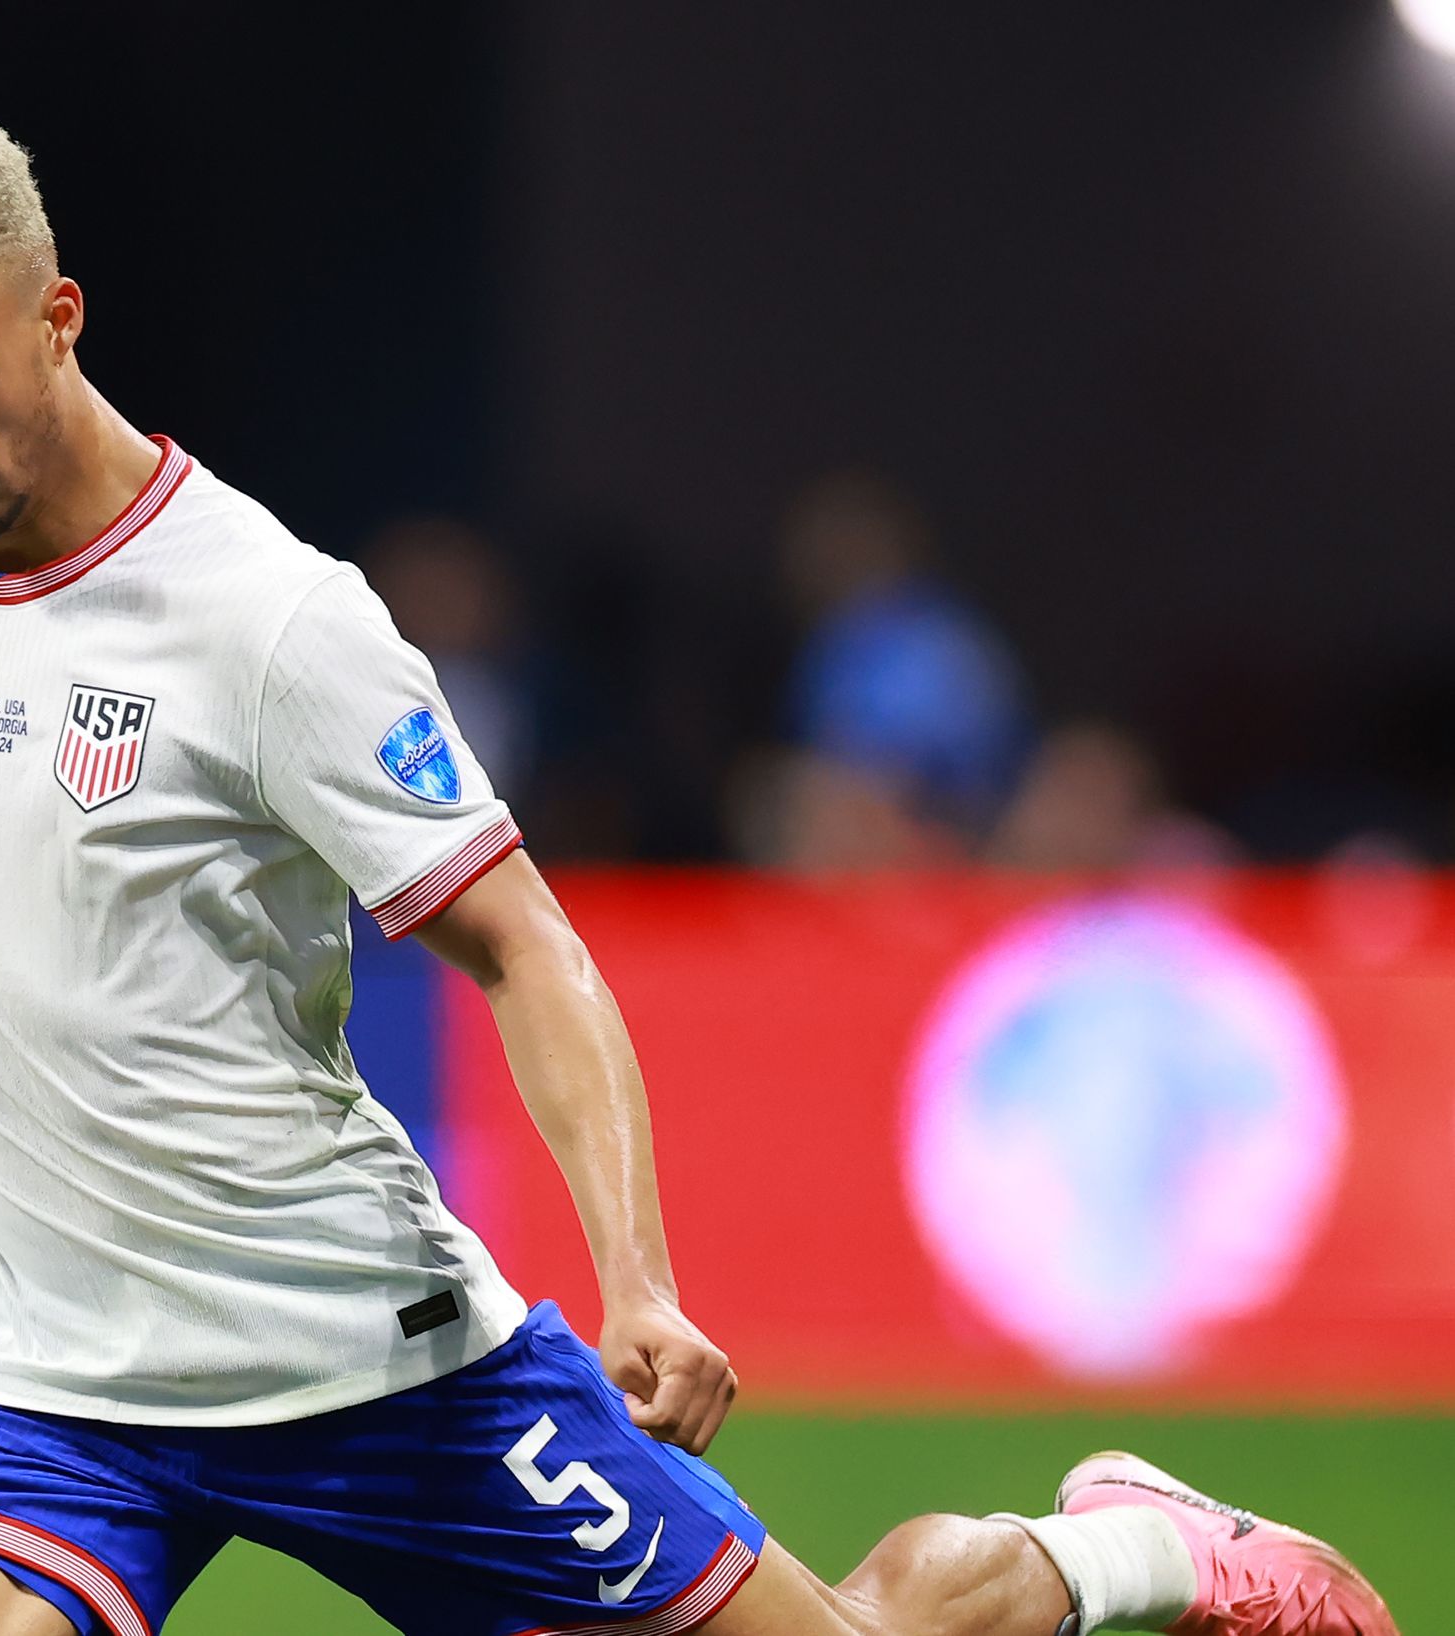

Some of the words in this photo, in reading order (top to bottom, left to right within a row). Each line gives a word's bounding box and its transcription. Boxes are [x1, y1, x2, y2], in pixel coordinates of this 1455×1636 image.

[4, 699, 25, 716] USA
[72, 693, 145, 741] USA
[397, 729, 440, 772] ROCKING
[502, 1412, 630, 1552] 5
